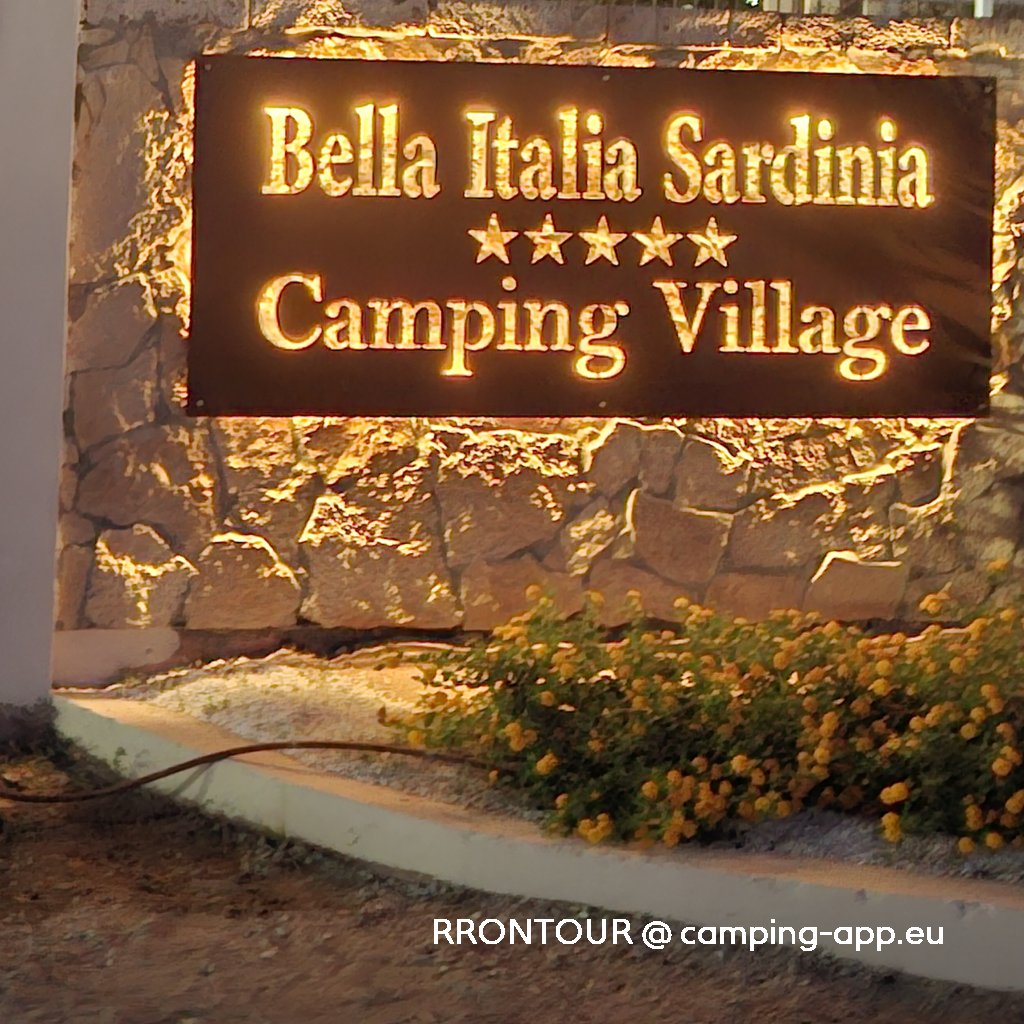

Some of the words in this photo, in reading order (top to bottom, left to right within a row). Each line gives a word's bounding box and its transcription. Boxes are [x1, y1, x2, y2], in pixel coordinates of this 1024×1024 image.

[262, 103, 441, 199] Bella
[464, 108, 642, 201] Italia
[663, 113, 935, 208] Sardinia
[258, 274, 630, 379] Camping
[652, 280, 931, 381] Village
